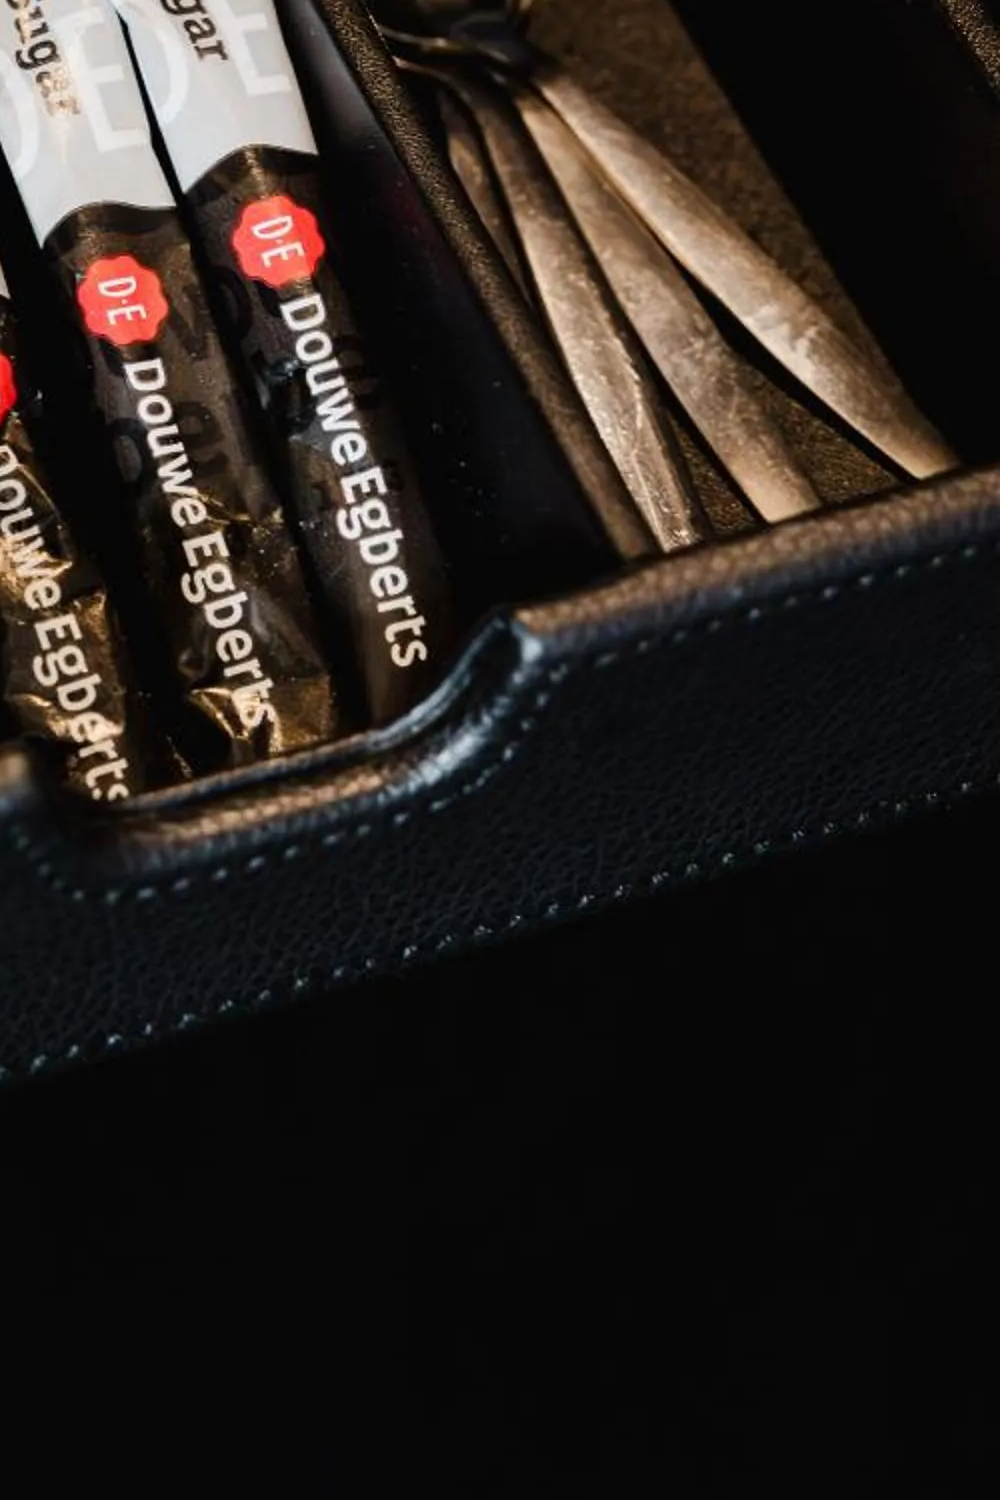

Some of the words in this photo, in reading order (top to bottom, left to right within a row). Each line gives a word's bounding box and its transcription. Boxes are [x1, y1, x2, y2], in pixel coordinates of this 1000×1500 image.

[123, 358, 206, 528] Douwe
[181, 532, 276, 729] Egberts
[280, 293, 367, 467] Douwe
[336, 466, 428, 668] Egberts
[33, 613, 129, 802] Egberts
